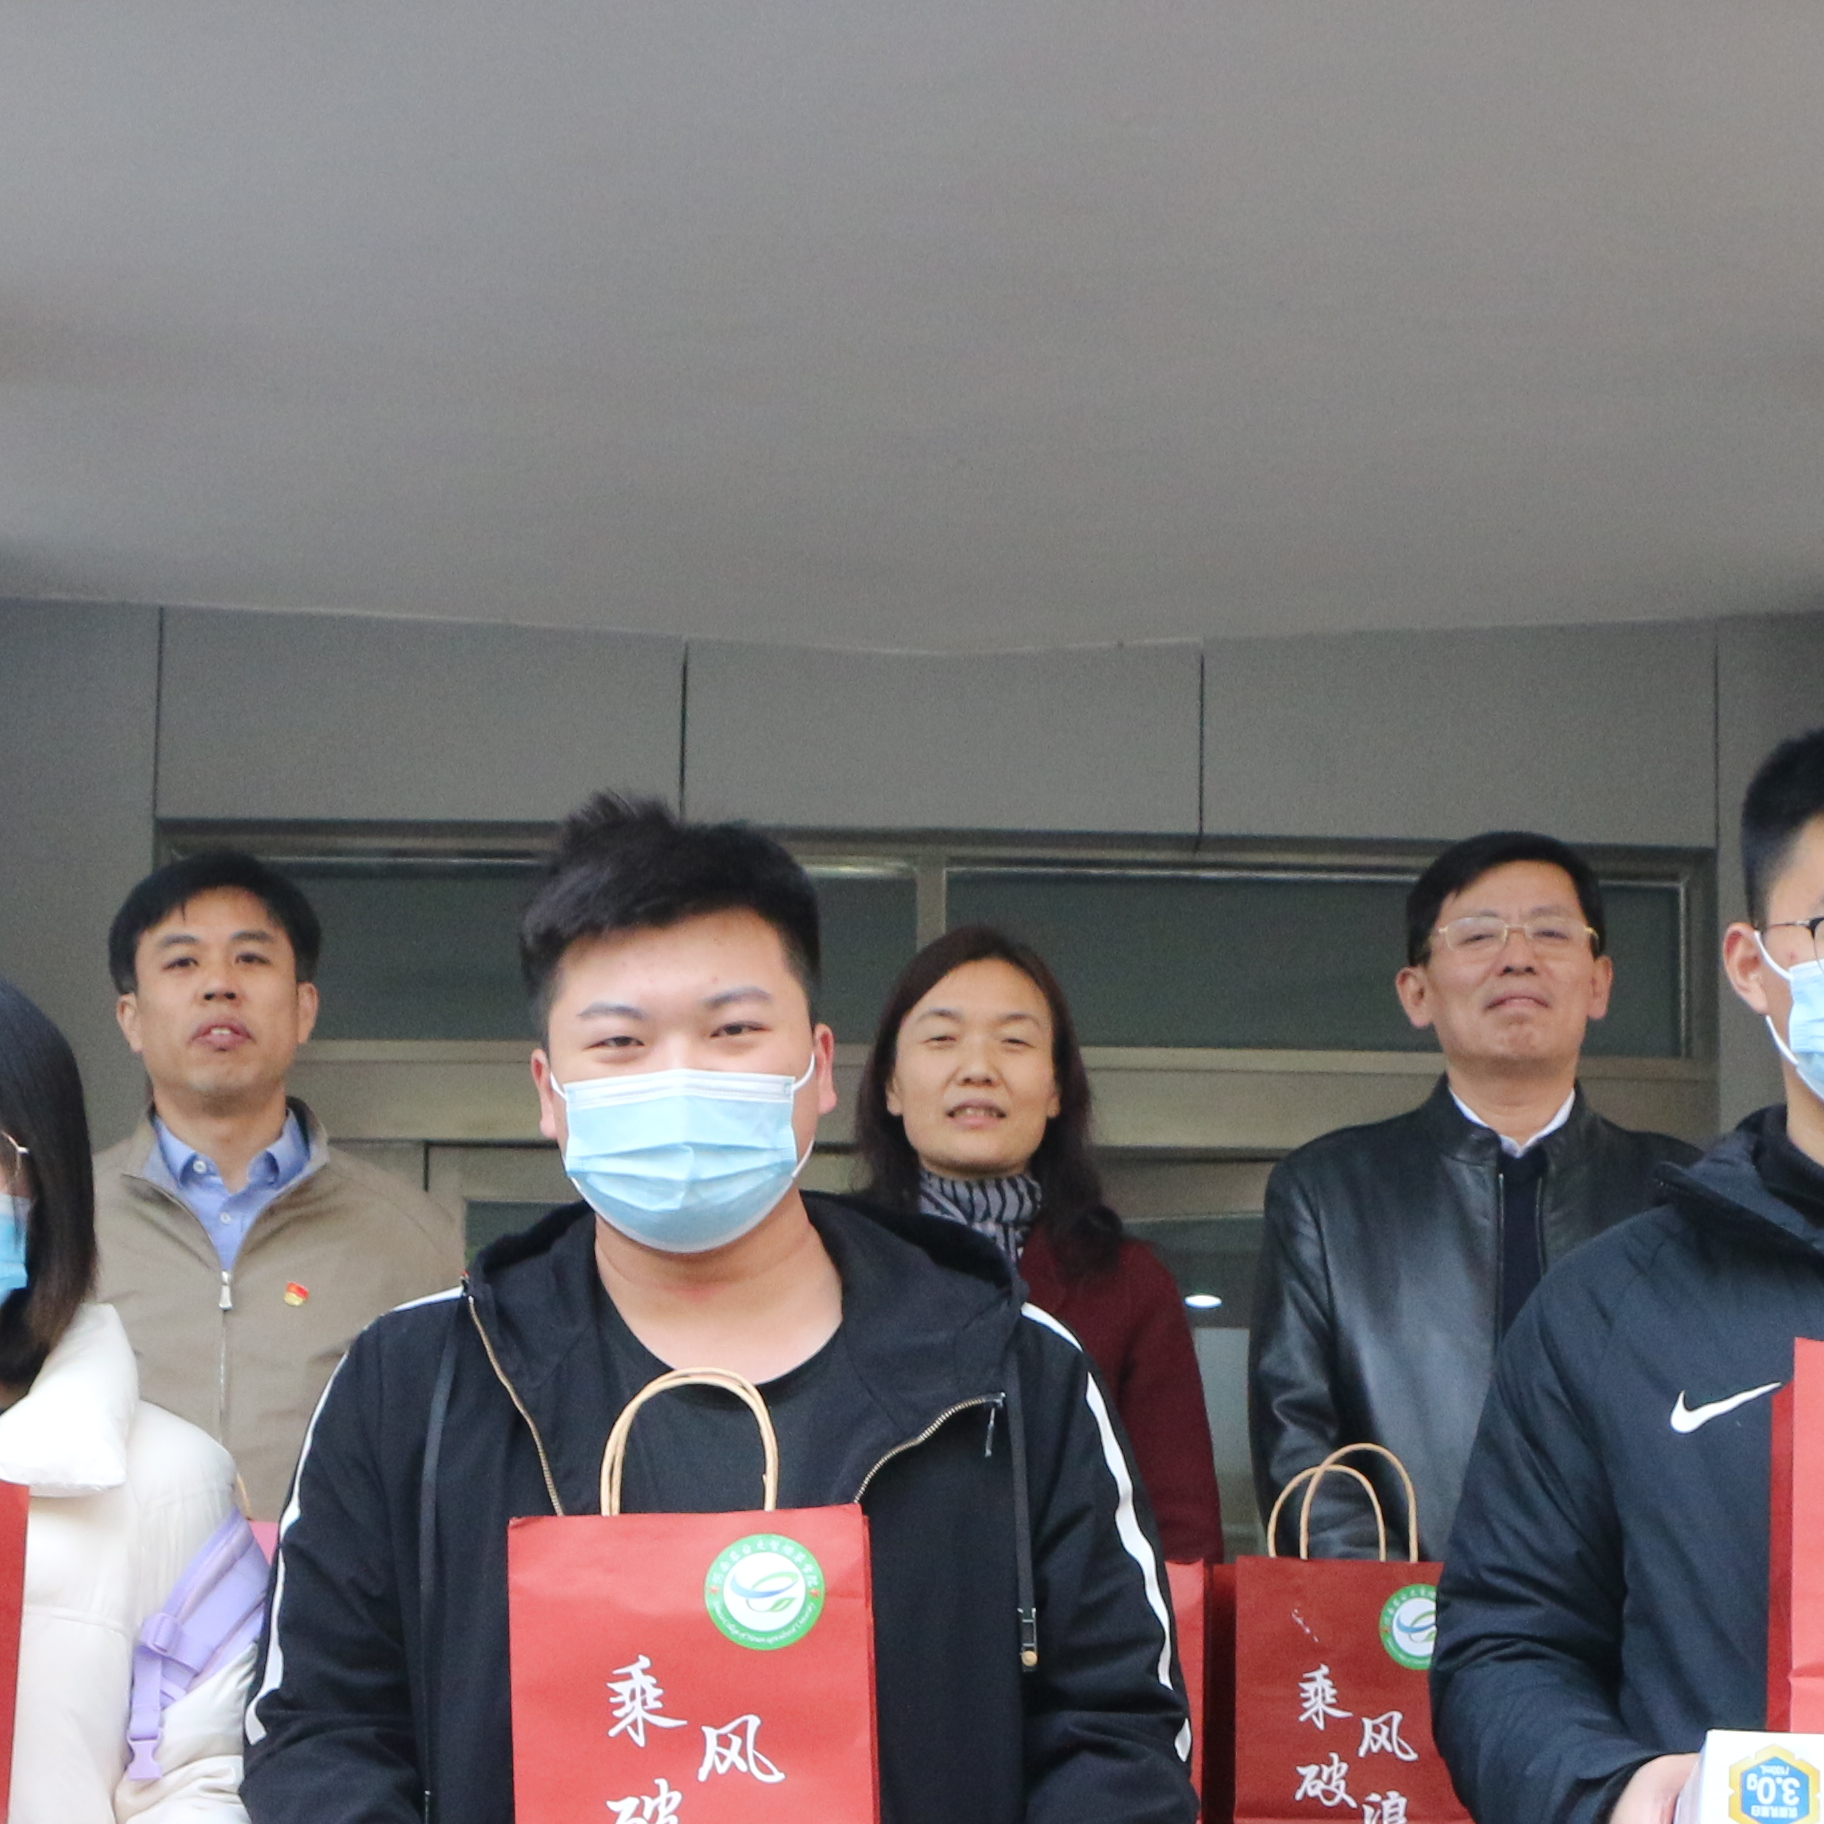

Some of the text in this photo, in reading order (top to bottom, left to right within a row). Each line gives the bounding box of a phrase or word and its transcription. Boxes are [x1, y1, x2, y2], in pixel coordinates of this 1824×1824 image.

[604, 1654, 786, 1784] 乘风
[1298, 1663, 1419, 1762] 乘风
[1746, 1773, 1801, 1806] 3.0g
